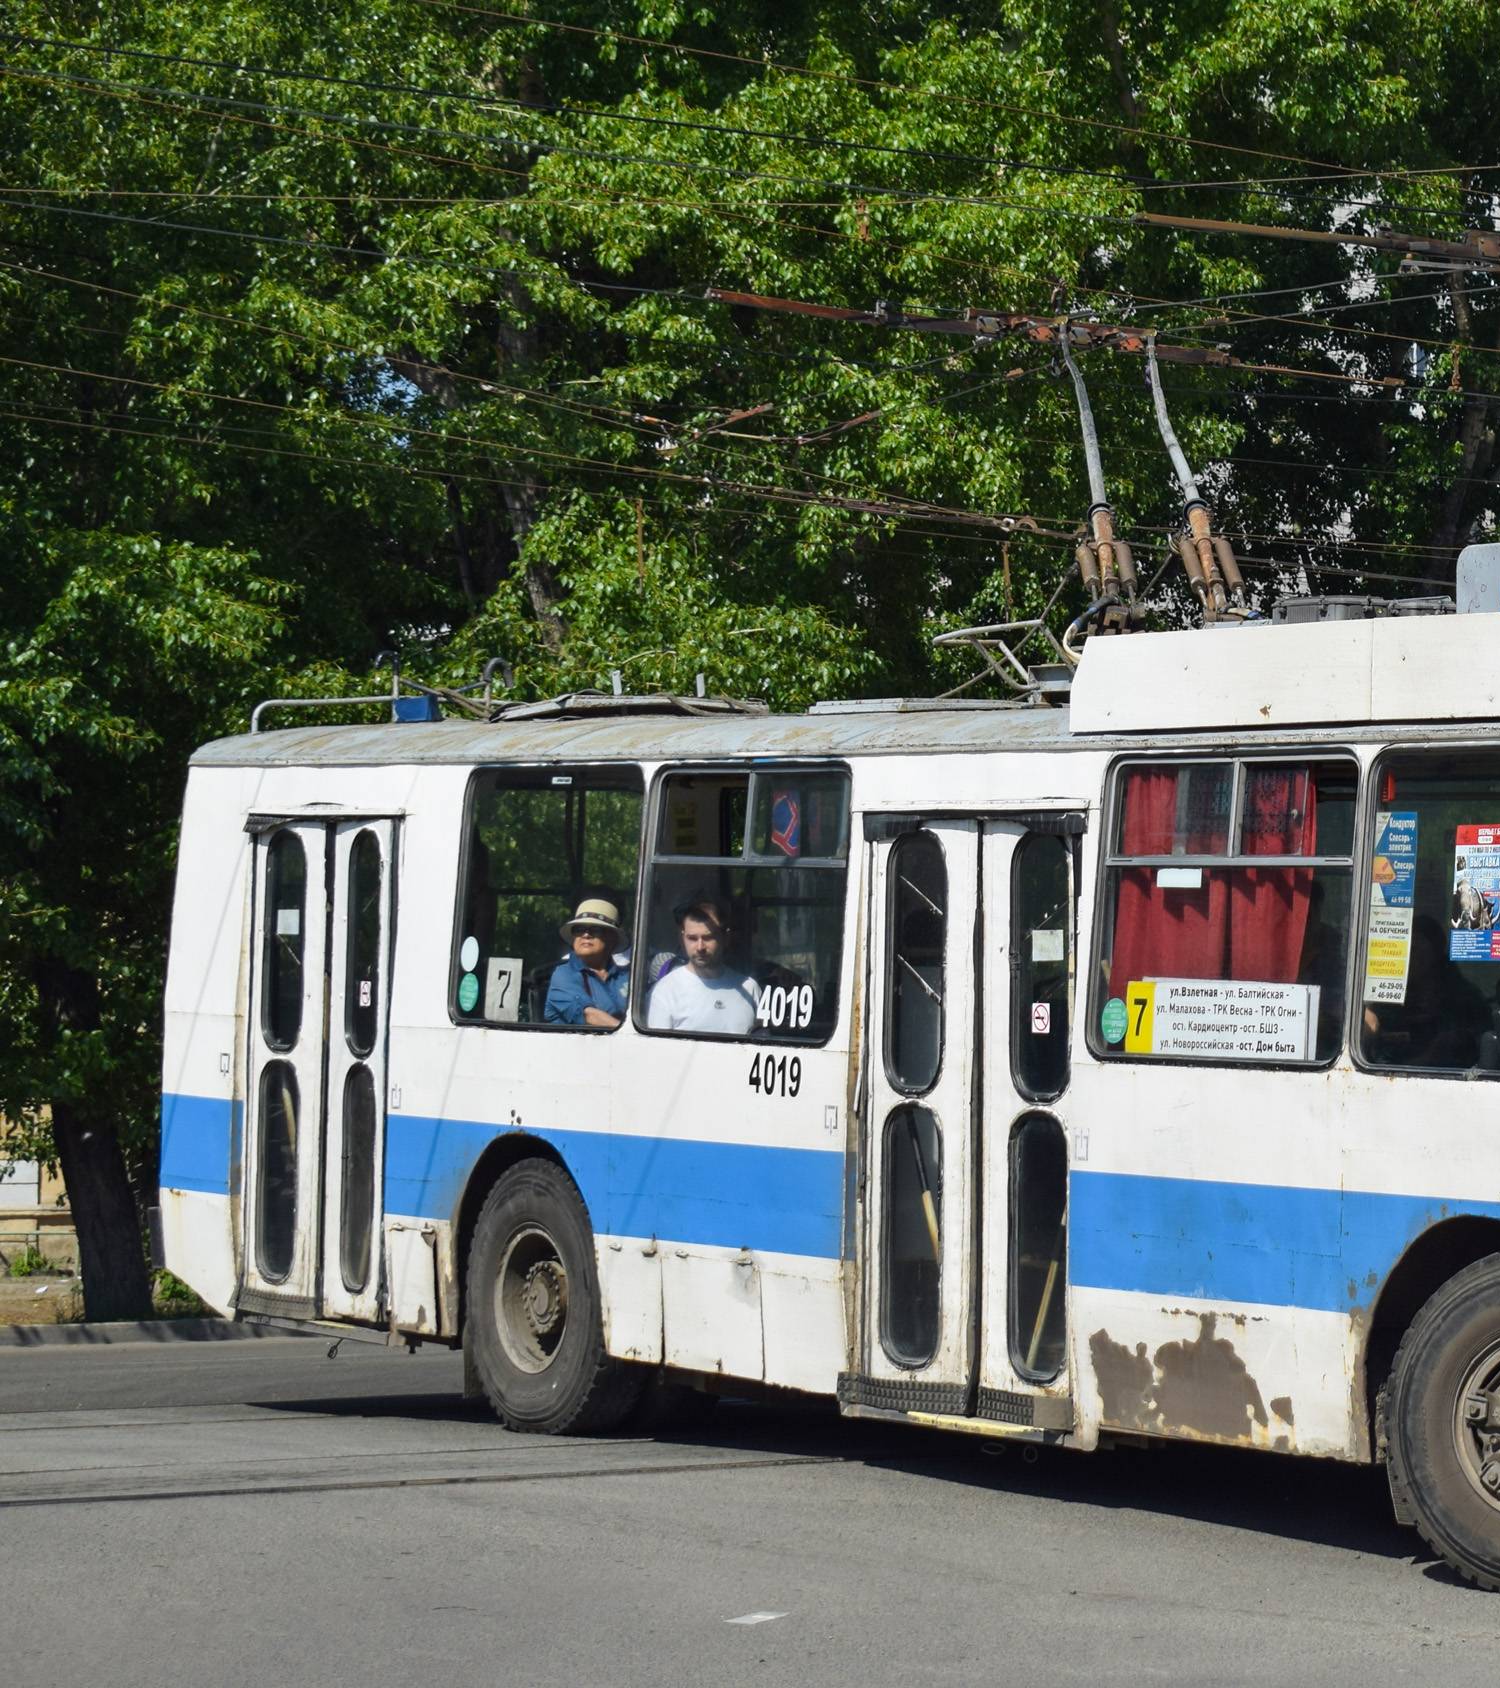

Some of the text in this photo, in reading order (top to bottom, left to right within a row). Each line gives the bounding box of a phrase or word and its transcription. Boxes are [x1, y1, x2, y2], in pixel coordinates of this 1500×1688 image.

[498, 970, 512, 1009] 7
[1225, 989, 1236, 1000] ул.
[1238, 987, 1284, 1000] Балтийская
[756, 984, 814, 1028] 4019
[1134, 998, 1148, 1037] 7
[1157, 1005, 1167, 1015] ул.
[1169, 1003, 1206, 1014] Малахова
[1213, 1004, 1228, 1015] ТРК
[1230, 1004, 1253, 1016] Весна
[1260, 1005, 1276, 1017] ТРК
[1278, 1006, 1297, 1018] Огни
[1172, 1022, 1186, 1031] ост.
[1188, 1020, 1238, 1034] Кардиоцентр
[1259, 1022, 1279, 1034] БШЗ
[1160, 1039, 1171, 1051] ул.
[1173, 1037, 1234, 1051] Новороссийская
[1256, 1040, 1273, 1053] Дом
[1275, 1041, 1296, 1053] быта
[748, 1052, 801, 1098] 4019
